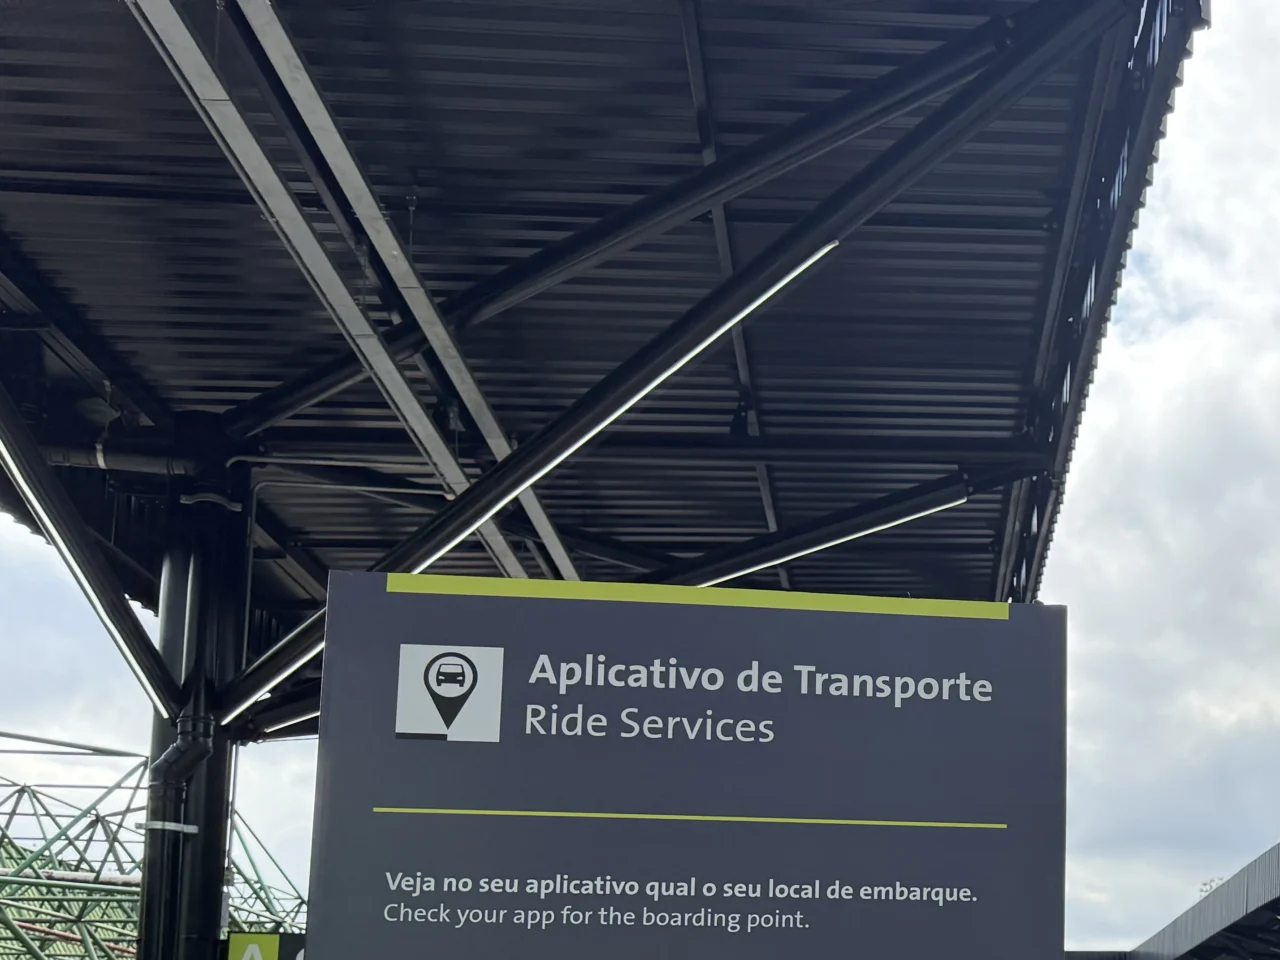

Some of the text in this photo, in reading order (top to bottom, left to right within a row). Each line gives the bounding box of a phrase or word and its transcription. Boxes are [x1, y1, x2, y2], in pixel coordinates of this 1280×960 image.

[528, 653, 994, 708] Aplicativo de Transporte
[525, 703, 776, 743] Ride Services
[385, 871, 979, 907] Veja no seu aplicativo qual o seu local de embarque.
[383, 902, 811, 934] Check your app for the boarding point.
